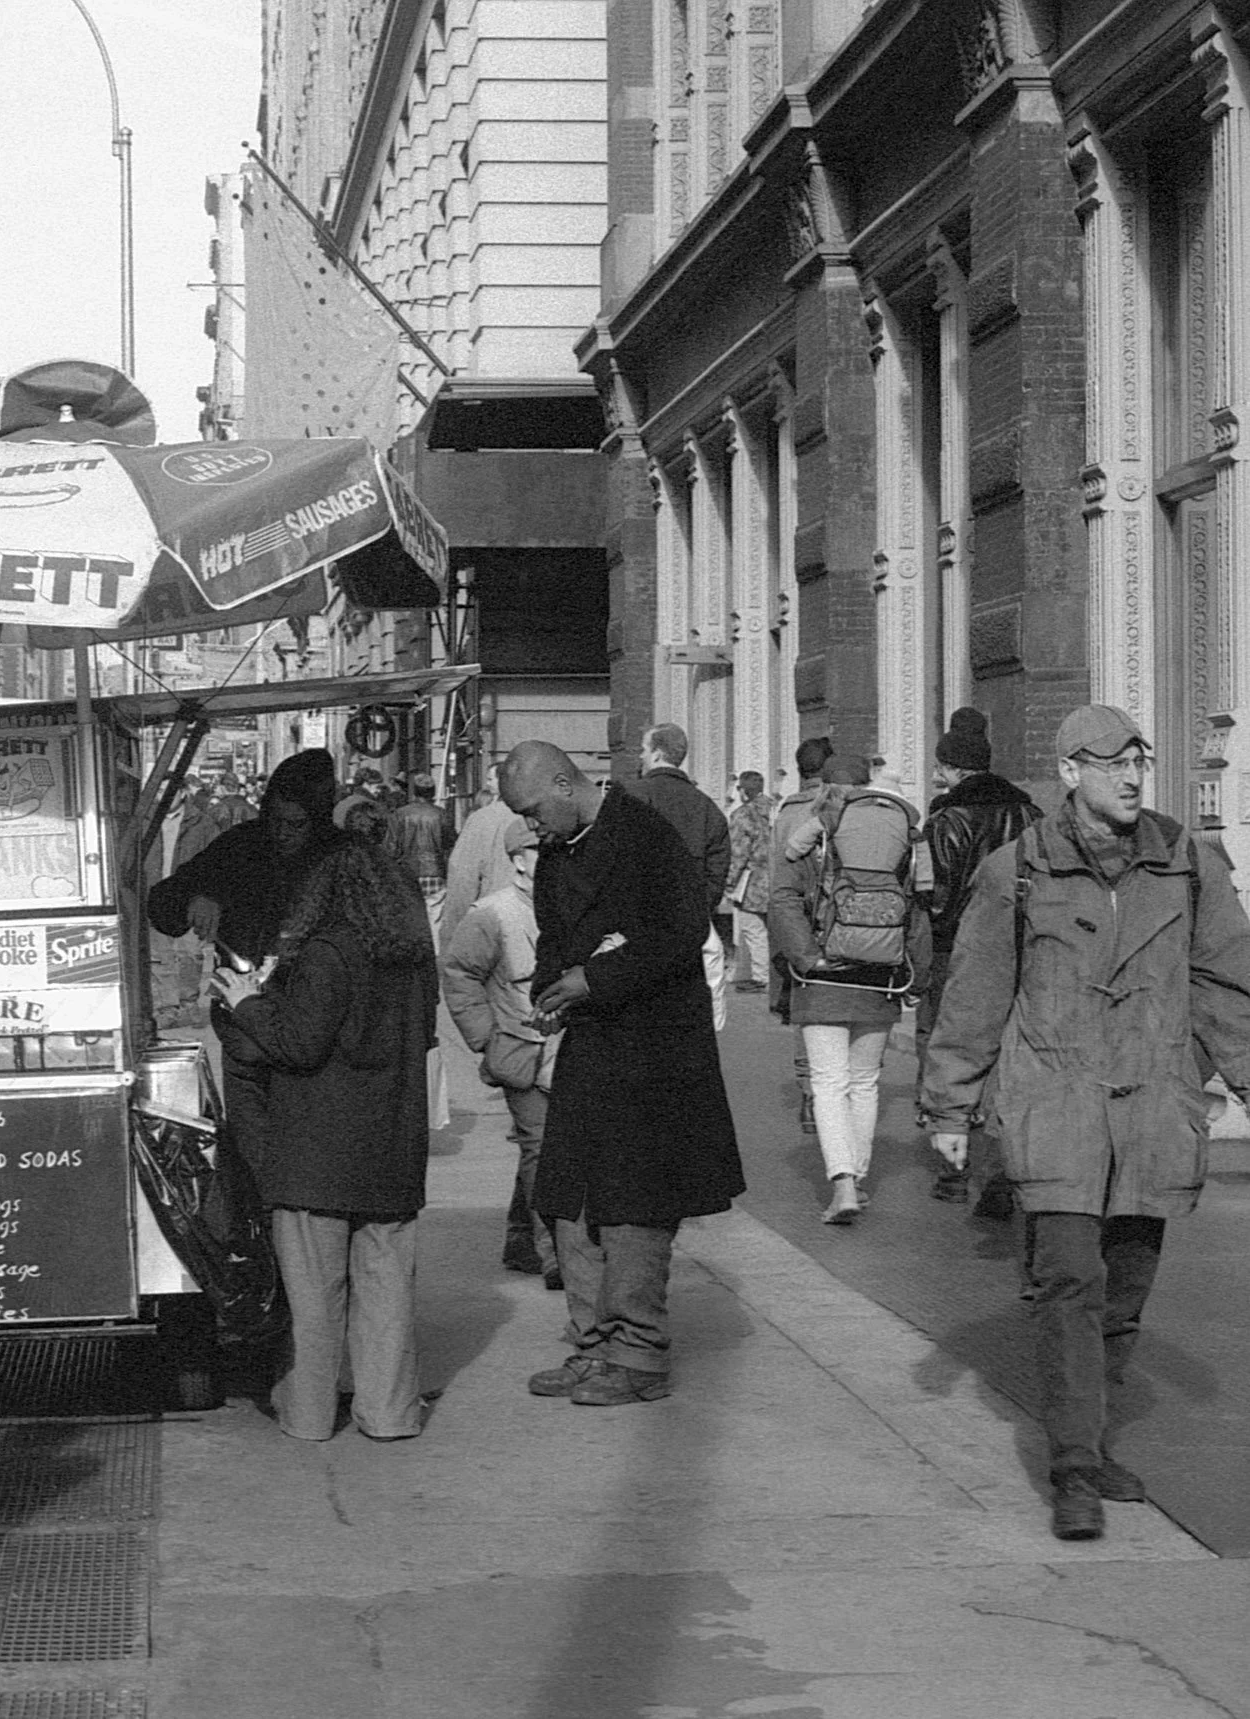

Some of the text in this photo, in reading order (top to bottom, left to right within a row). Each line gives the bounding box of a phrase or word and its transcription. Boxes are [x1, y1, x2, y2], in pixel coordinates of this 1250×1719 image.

[200, 480, 378, 581] HOT SAUSAGES
[0, 930, 35, 948] diet
[51, 929, 114, 968] Sprite
[19, 1150, 83, 1169] SODAS
